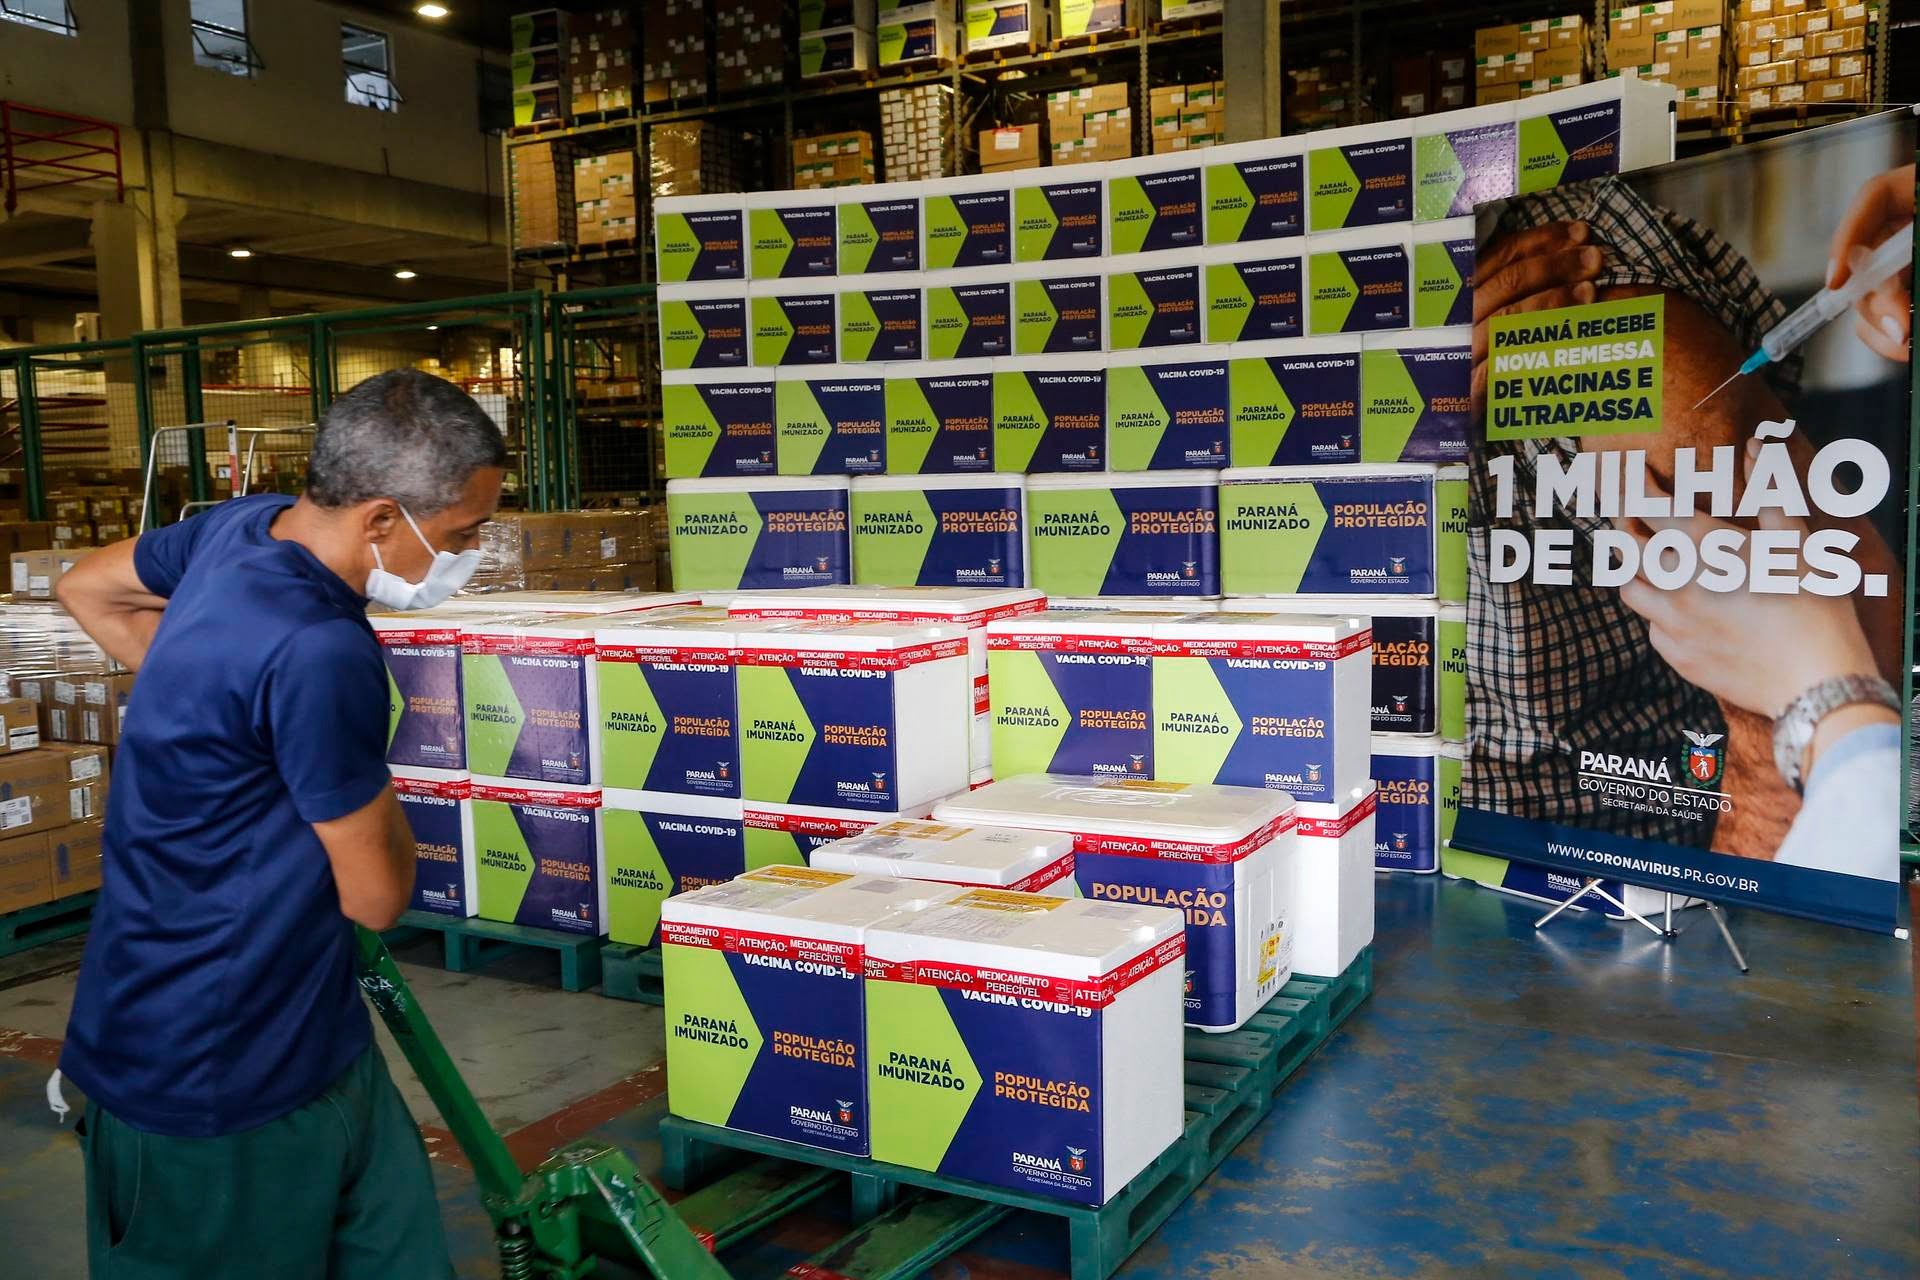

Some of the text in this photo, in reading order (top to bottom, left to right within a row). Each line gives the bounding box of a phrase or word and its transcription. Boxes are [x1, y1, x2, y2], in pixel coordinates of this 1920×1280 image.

[1495, 313, 1655, 348] PARANÁ RECEBE
[1495, 340, 1655, 373] NOVA REMESSA
[1283, 359, 1354, 370] VACINA COVID-19
[1495, 367, 1652, 399] DE VACINAS E
[1243, 404, 1278, 413] PARANÁ
[1302, 401, 1354, 411] POPULAÇÃO
[1237, 413, 1285, 421] IMUNIZADO
[1302, 409, 1354, 418] PROTEGIDA
[1494, 397, 1652, 428] ULTRAPASSA
[1311, 443, 1338, 451] PARANÁ
[1488, 419, 1890, 518] 1 MILHÃO
[1238, 503, 1298, 517] PARANÁ
[1334, 501, 1427, 515] POPULAÇÃO
[685, 512, 737, 523] PARANÁ
[768, 509, 845, 522] POPULAÇÃO
[865, 510, 913, 523] PARANÁ
[942, 509, 1017, 522] POPULAÇÃO
[1044, 511, 1099, 523] PARANÁ
[1132, 508, 1215, 522] POPULAÇÃO
[768, 521, 845, 532] PROTEGIDA
[943, 522, 1017, 532] PROTEGIDA
[1227, 518, 1310, 530] IMUNIZADO
[1334, 515, 1427, 528] PROTEGIDA
[676, 525, 748, 535] IMUNIZADO
[857, 525, 922, 534] IMUNIZADO
[1035, 525, 1110, 536] IMUNIZADO
[1132, 522, 1215, 534] PROTEGIDA
[1489, 529, 1888, 597] DE DOSES.
[784, 566, 814, 574] PARANÁ
[957, 568, 985, 576] PARANÁ
[1147, 571, 1179, 579] PARANÁ
[1351, 568, 1386, 577] PARANÁ
[1078, 640, 1119, 648] ATENÇÃO:
[1256, 645, 1300, 654] ATENÇÃO:
[602, 649, 634, 658] ATENÇÃO:
[692, 652, 726, 661] ATENÇÃO:
[759, 654, 795, 662] ATENÇÃO:
[1190, 648, 1230, 656] PERECÍVEL
[803, 659, 838, 667] PERECÍVEL
[1056, 655, 1146, 665] VACINA COVID-19
[1226, 658, 1326, 671] VACINA COVID-19
[652, 663, 729, 672] VACINA COVID-19
[800, 668, 886, 678] VACINA COVID-19
[612, 712, 649, 722] PARANÁ
[1005, 706, 1050, 716] PARANÁ
[1080, 710, 1146, 720] POPULAÇÃO
[674, 717, 729, 727] POPULAÇÃO
[998, 717, 1059, 727] IMUNIZADO
[1171, 713, 1219, 723] PARANÁ
[1253, 717, 1324, 729] POPULAÇÃO
[605, 722, 656, 732] IMUNIZADO
[754, 720, 795, 730] PARANÁ
[824, 725, 886, 736] POPULAÇÃO
[1080, 720, 1146, 729] PROTEGIDA
[1162, 723, 1228, 734] IMUNIZADO
[674, 725, 730, 737] PROTEGIDA
[747, 730, 804, 742] IMUNIZADO
[1253, 727, 1324, 738] PROTEGIDA
[824, 734, 886, 746] PROTEGIDA
[1093, 764, 1127, 772] PARANÁ
[1580, 751, 1671, 782] PARANÁ
[686, 770, 715, 779] PARANÁ
[1265, 773, 1302, 783] PARANÁ
[837, 782, 869, 791] PARANÁ
[838, 791, 860, 799] GOVERNO
[1579, 778, 1731, 813] GOVERNO DO ESTADO
[522, 807, 589, 823] VACINA COVID-19
[1602, 798, 1703, 821] SECRETARIA DA SAÚDE
[1101, 841, 1147, 853] ATENÇÃO:
[1151, 841, 1212, 853] MEDICAMENTO
[487, 850, 519, 861] PARANÁ
[1159, 851, 1204, 862] PERECÍVEL
[481, 858, 526, 871] IMUNIZADO
[541, 859, 590, 872] POPULAÇÃO
[1547, 842, 1759, 893] WWW.CORONAVIRUS.PR.GOV.BR
[542, 867, 590, 882] PROTEGIDA
[1548, 873, 1581, 887] PARANÁ
[1093, 883, 1226, 909] POPULAÇÃO
[552, 908, 577, 919] PARANÁ
[662, 923, 719, 937] MEDICAMENTO
[669, 934, 712, 946] PERECÍVEL
[739, 937, 787, 952] ATENÇÃO:
[1155, 934, 1185, 957] MEDICAMENTO
[790, 939, 853, 955] MEDICAMENTO
[799, 951, 846, 964] PERECÍVEL
[1159, 947, 1181, 965] PERECÍVEL
[743, 953, 792, 970] VACINA
[795, 961, 854, 979] COVID-19
[1128, 957, 1153, 978] ATENÇÃO:
[918, 967, 973, 983] ATENÇÃO:
[977, 970, 1049, 988] MEDICAMENTO
[986, 982, 1040, 998] PERECÍVEL
[961, 989, 1091, 1018] VACINA COVID-19
[684, 1014, 737, 1034] PARANÁ
[675, 1026, 748, 1049] IMUNIZADO
[774, 1031, 855, 1055] POPULAÇÃO
[774, 1043, 855, 1068] PROTEGIDA
[890, 1052, 952, 1074] PARANÁ
[879, 1064, 964, 1090] IMUNIZADO
[995, 1071, 1090, 1099] POPULAÇÃO
[995, 1086, 1090, 1113] PROTEGIDA
[791, 1106, 832, 1123] PARANÁ
[791, 1119, 821, 1131] GOVERNO
[822, 1124, 832, 1133] DO
[833, 1126, 858, 1137] ESTADO
[1013, 1153, 1062, 1171] PARANÁ
[1013, 1166, 1048, 1178] GOVERNO
[1063, 1176, 1091, 1187] ESTADO
[1026, 1176, 1053, 1185] SECRETARIA
